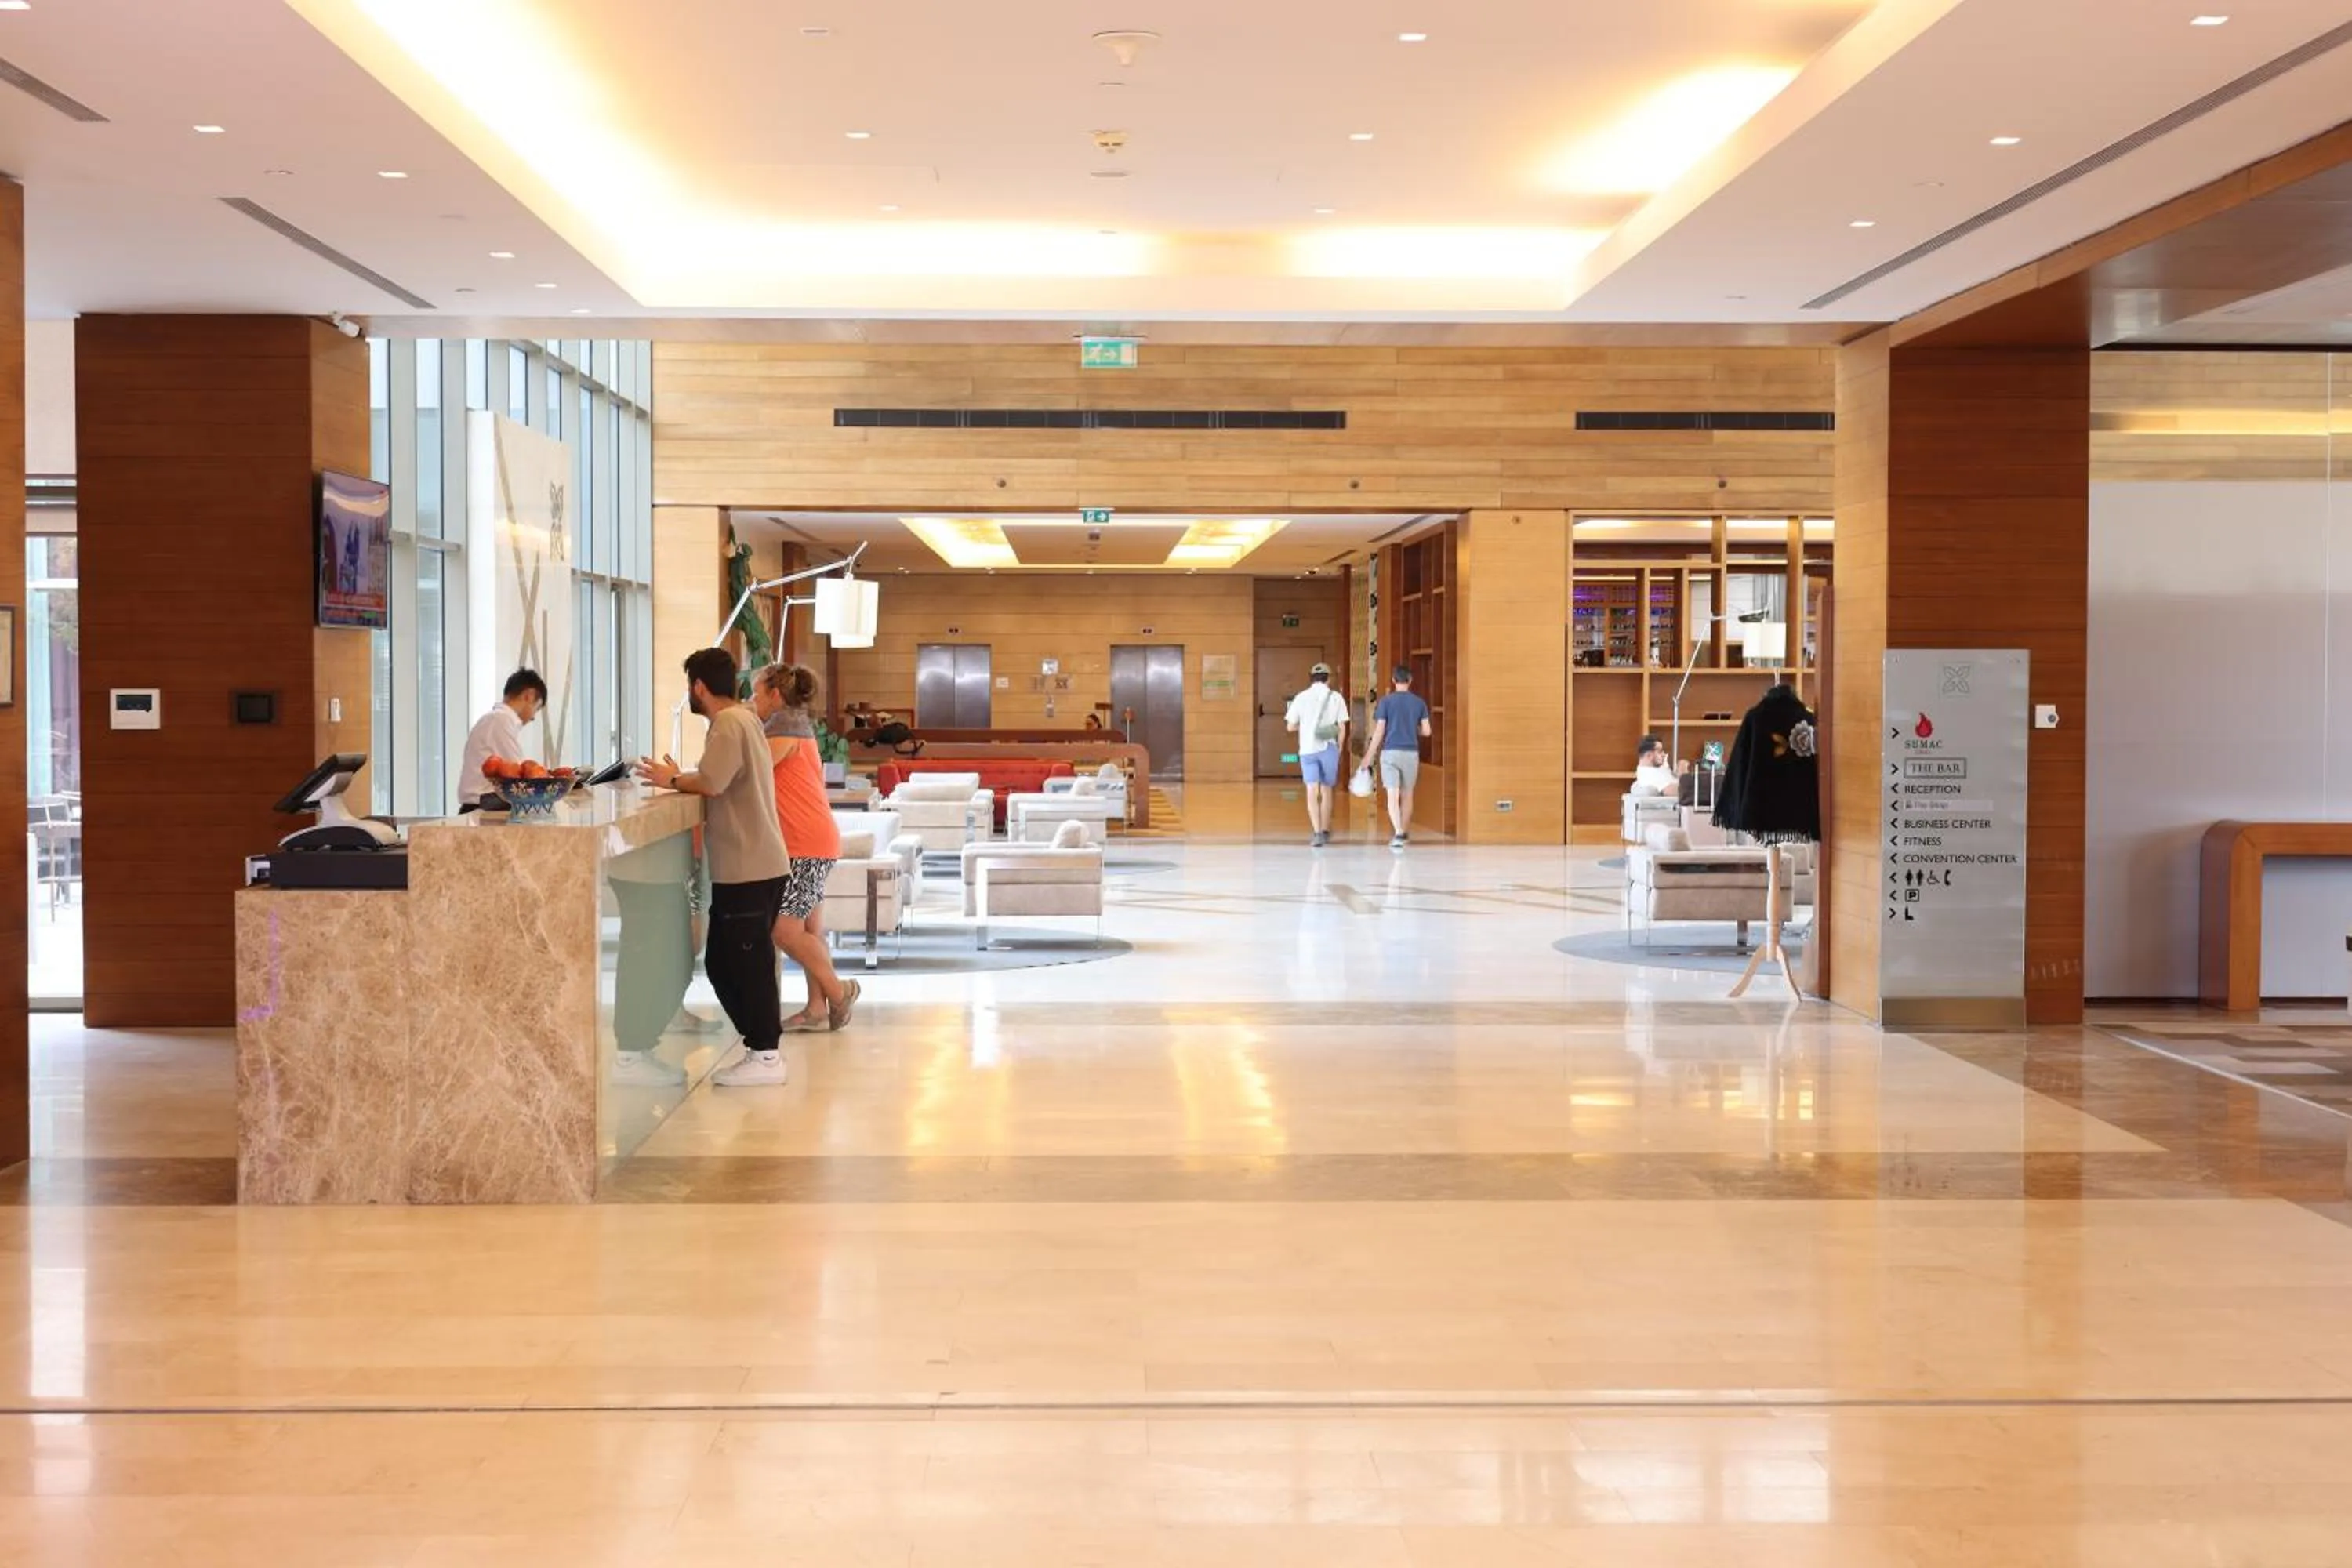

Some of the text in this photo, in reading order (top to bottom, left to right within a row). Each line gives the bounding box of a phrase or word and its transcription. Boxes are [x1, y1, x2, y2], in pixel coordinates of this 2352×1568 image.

[1904, 739, 1943, 749] SUMAC
[1911, 763, 1960, 774] THE BAR
[1904, 785, 1961, 794] RECEPTION
[1904, 819, 1991, 829] BUSINESS CENTER
[1904, 837, 1942, 846] FITNESS
[1903, 854, 2017, 863] CONVENTION CENTER
